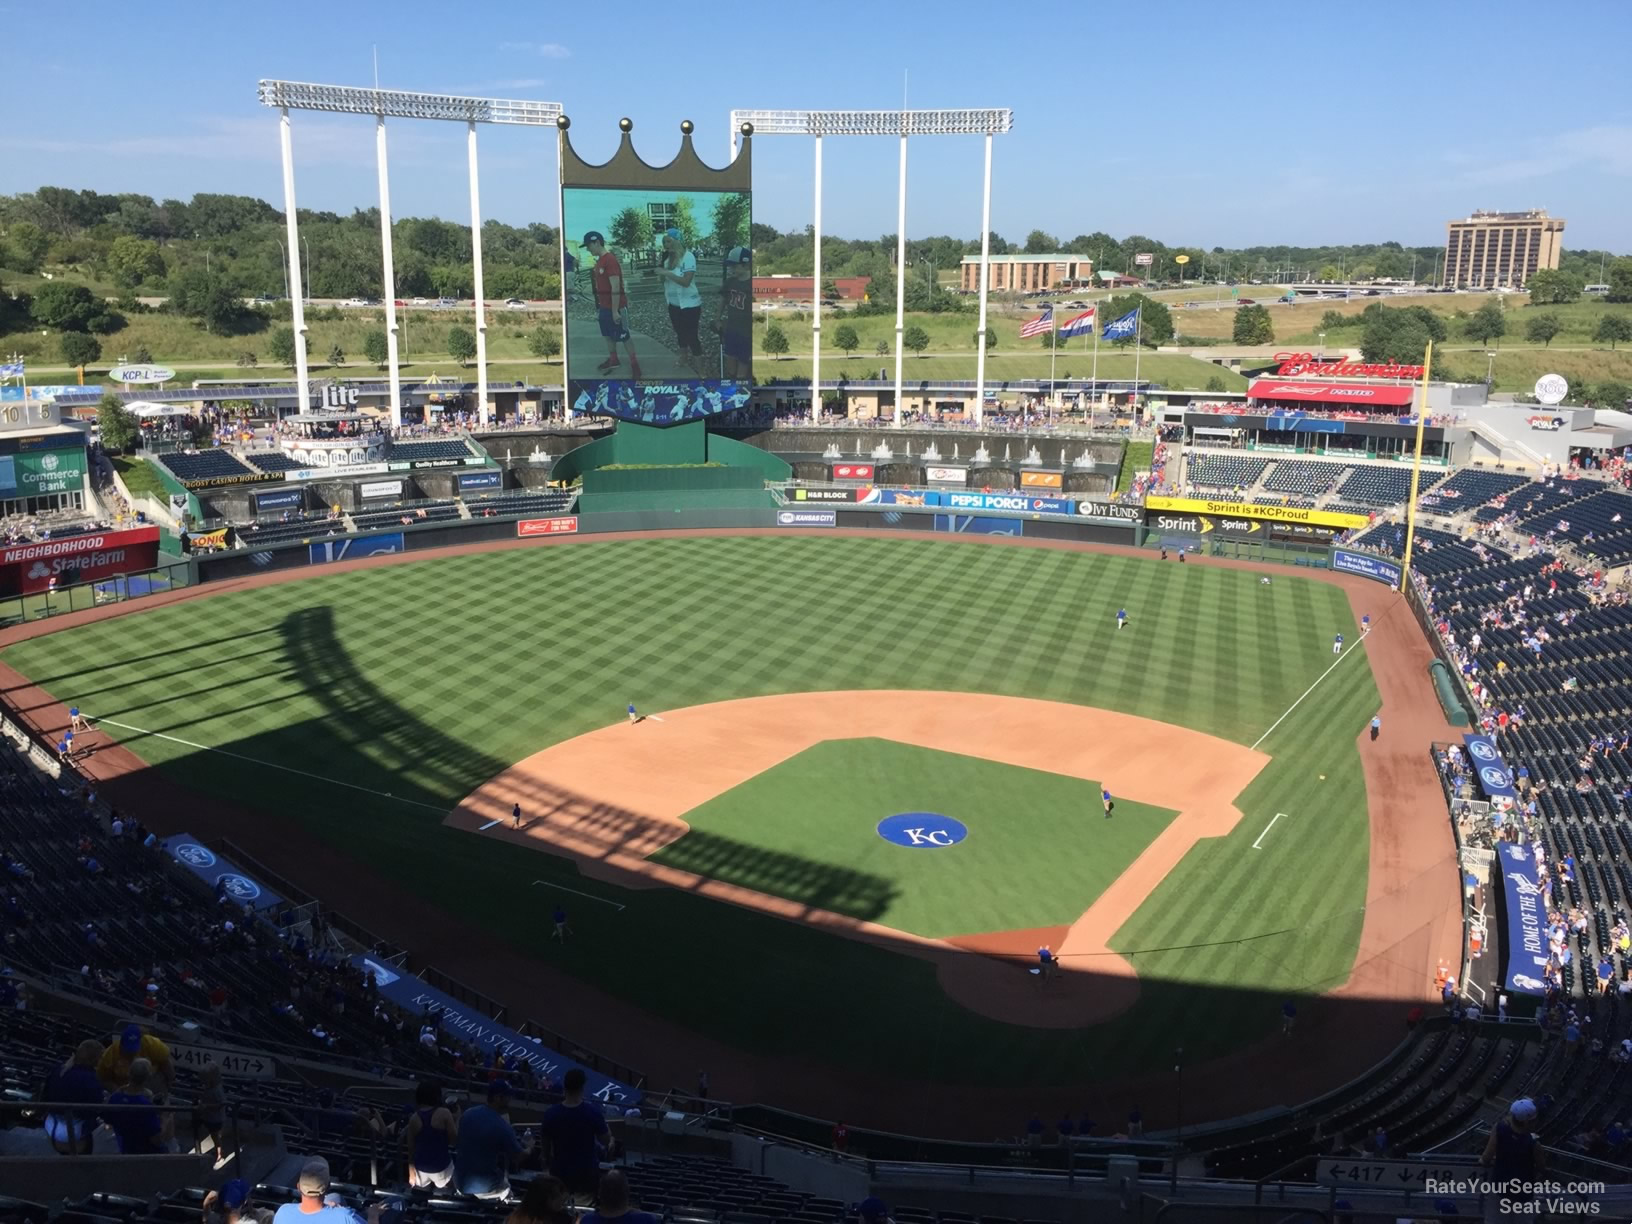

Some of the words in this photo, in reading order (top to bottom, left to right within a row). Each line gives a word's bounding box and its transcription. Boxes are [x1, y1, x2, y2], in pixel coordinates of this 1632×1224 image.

[1273, 352, 1425, 378] Budweiser
[321, 383, 360, 410] Lite
[644, 385, 680, 394] ROYAL
[1, 406, 19, 424] 10
[40, 404, 51, 420] 5
[22, 469, 79, 483] Commerce
[39, 480, 67, 492] Bank
[951, 495, 982, 506] PEPSI
[985, 497, 1028, 510] PORCH
[1207, 502, 1240, 513] Sprint
[1242, 504, 1251, 514] is
[1253, 507, 1309, 519] #KCProud
[1158, 516, 1197, 532] Sprint
[1221, 519, 1248, 531] Sprint
[192, 535, 225, 546] SONIC
[5, 537, 104, 562] NEIGHBORHOOD
[903, 828, 954, 846] KC
[1519, 895, 1537, 912] THE
[1521, 913, 1539, 925] OF
[1522, 924, 1542, 953] HOME
[484, 1033, 558, 1074] STADIUM
[222, 1056, 251, 1072] 417
[1348, 1166, 1386, 1182] 417
[1416, 1168, 1453, 1184] 418
